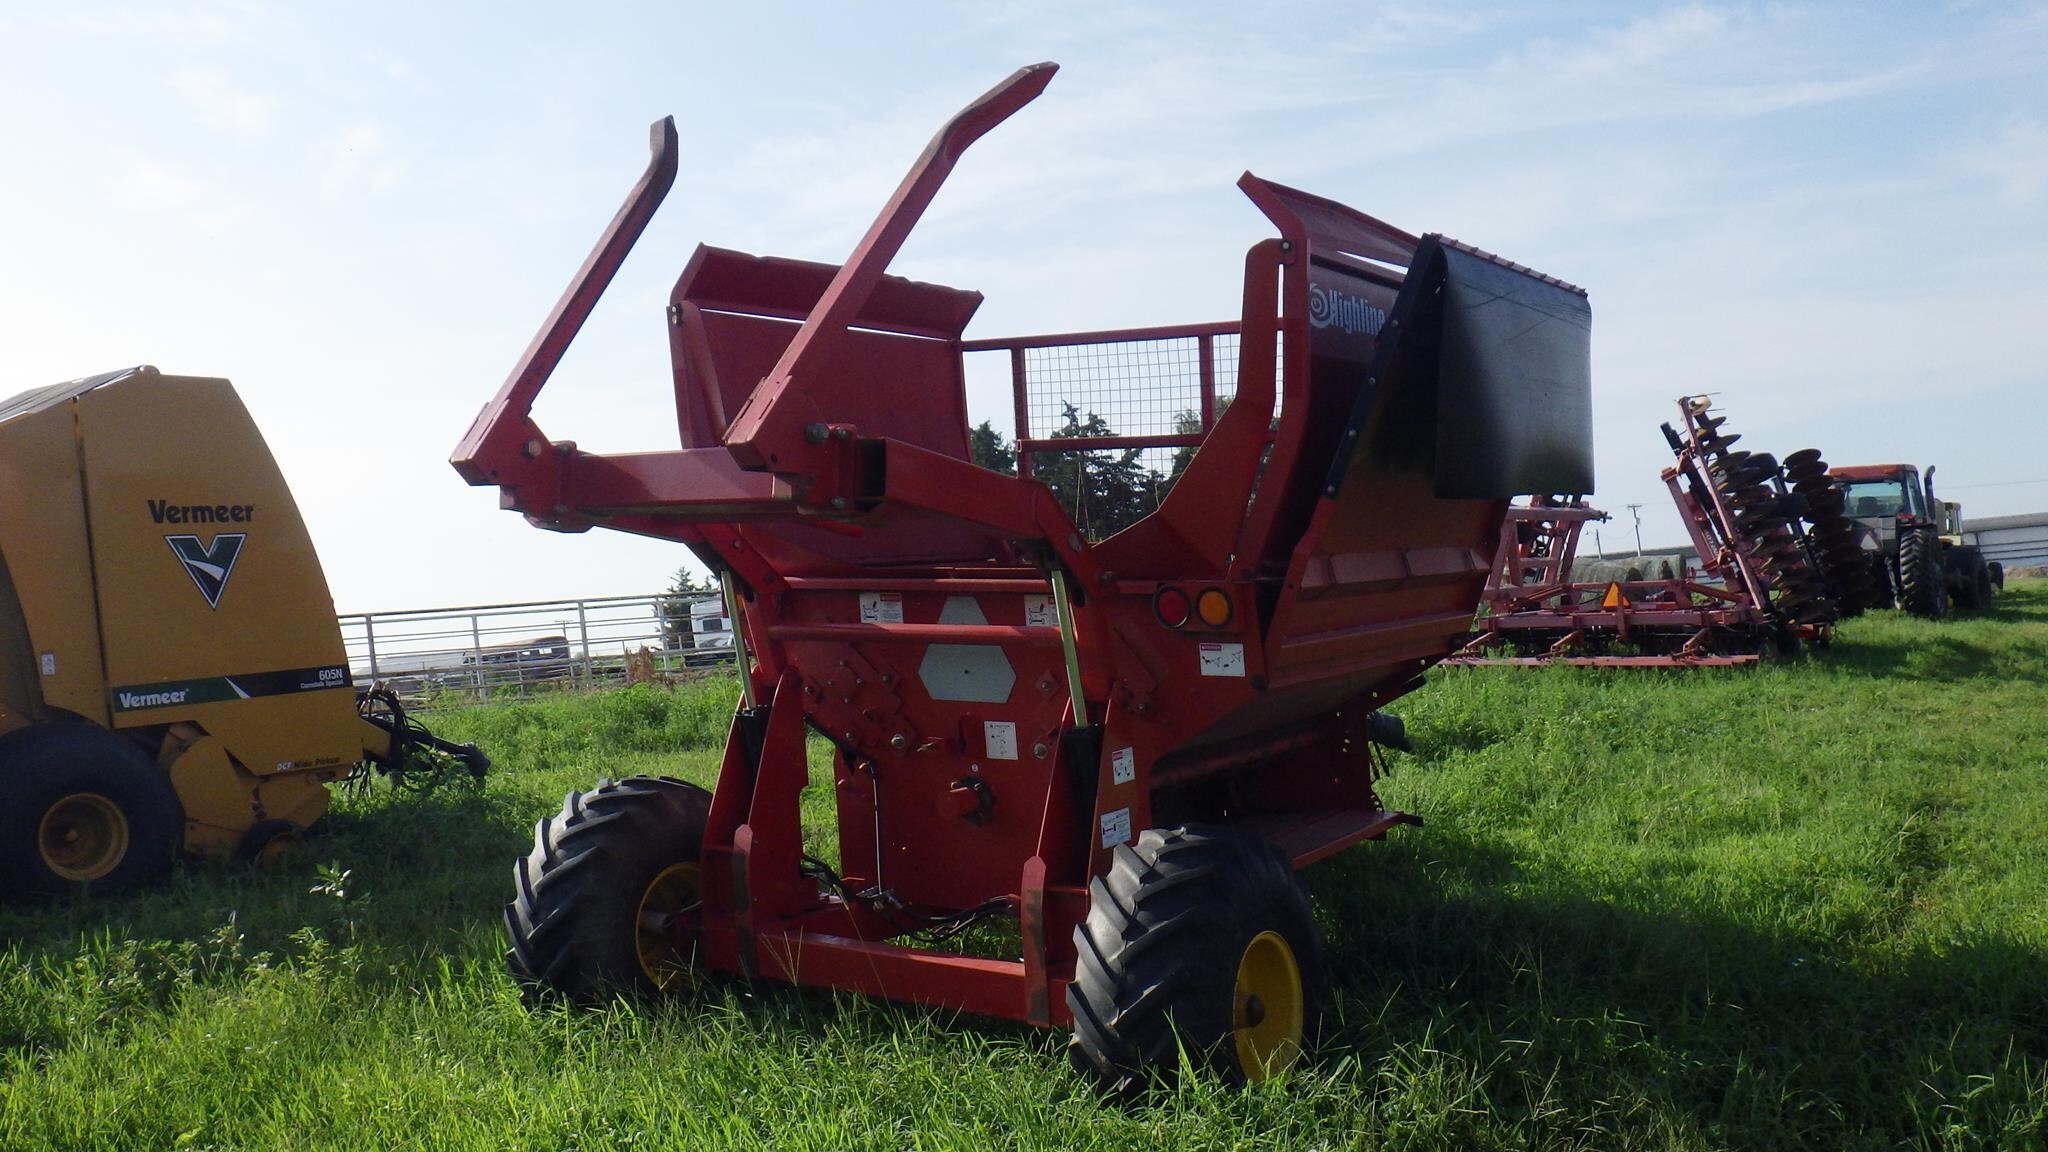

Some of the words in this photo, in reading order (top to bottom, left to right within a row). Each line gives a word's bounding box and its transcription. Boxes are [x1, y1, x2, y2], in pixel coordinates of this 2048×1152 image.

[148, 499, 254, 524] Vermeer
[319, 669, 343, 681] 605N
[119, 690, 186, 708] Vermeer
